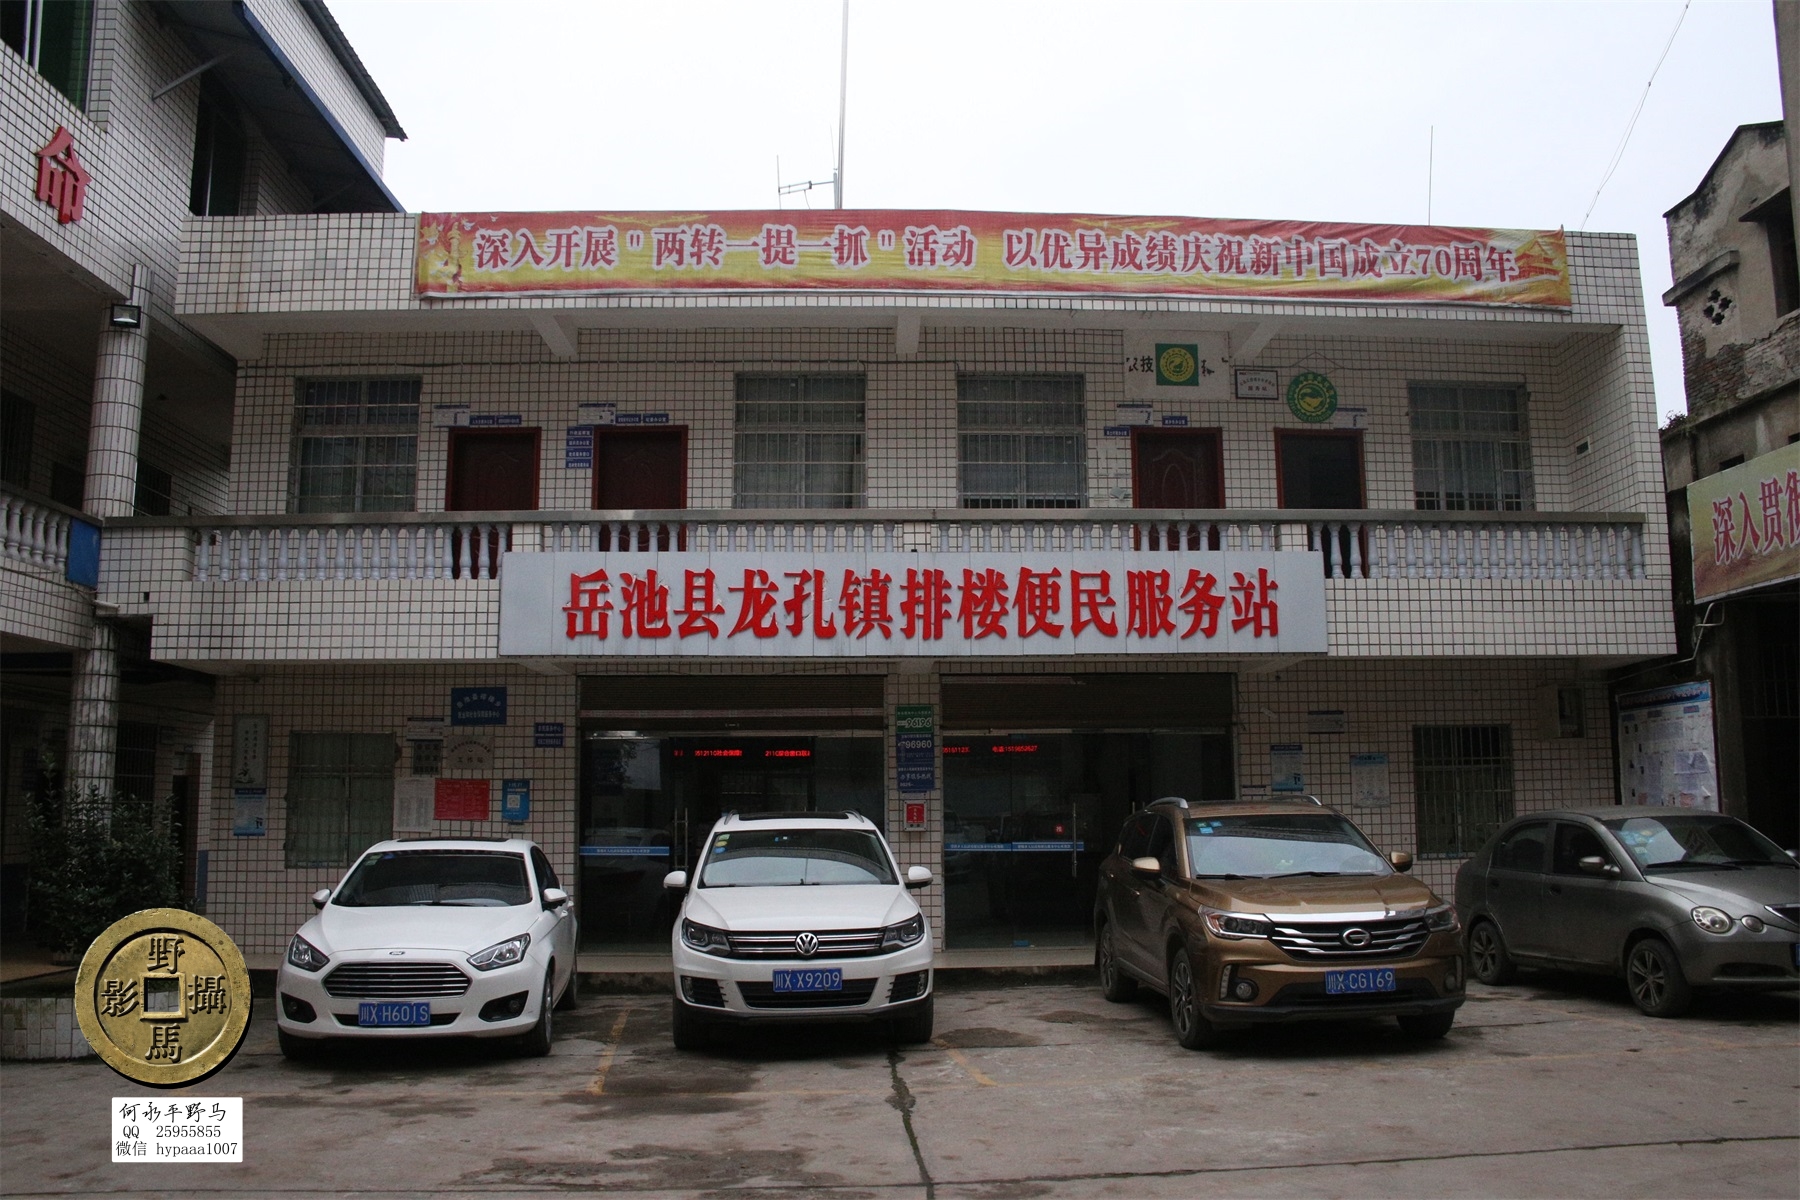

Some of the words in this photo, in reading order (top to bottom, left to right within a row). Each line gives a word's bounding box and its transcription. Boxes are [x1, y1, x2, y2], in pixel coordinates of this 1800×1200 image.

[36, 126, 92, 224] 命
[1003, 227, 1519, 283] 以优异成绩庆祝新中国成立70周年
[561, 566, 1281, 640] 岳池县龙孔镇排楼便民服务站
[905, 739, 932, 749] 96960
[906, 717, 932, 728] 96196
